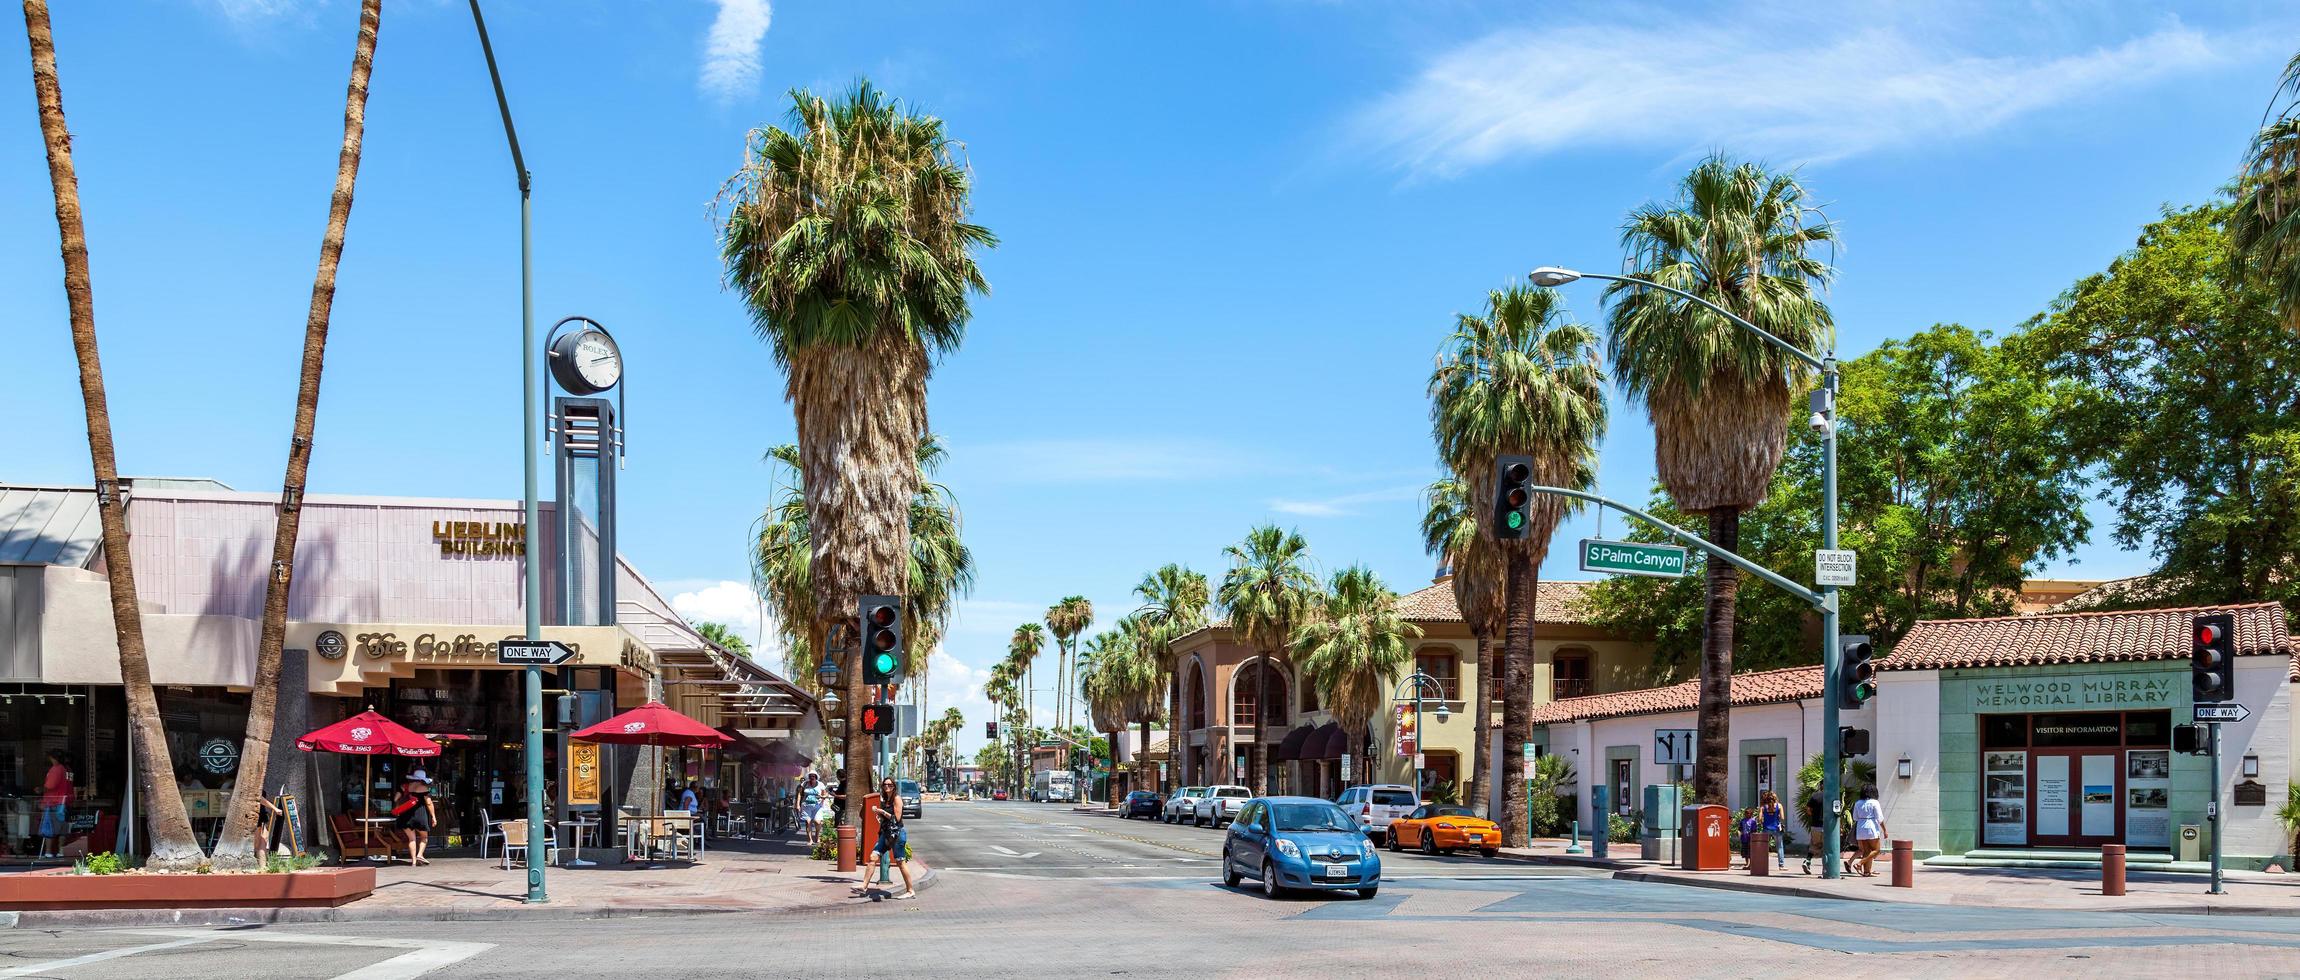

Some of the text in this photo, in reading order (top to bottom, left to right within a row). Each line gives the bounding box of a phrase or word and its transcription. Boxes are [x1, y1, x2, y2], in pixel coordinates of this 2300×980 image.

[583, 344, 608, 357] ROLEX
[1590, 547, 1681, 569] S Palm Canyon
[1819, 553, 1853, 563] DO NOT BLOCK
[1820, 563, 1852, 572] INTERSECTION
[356, 632, 498, 659] The Coffee
[506, 647, 551, 657] ONE WAY
[1977, 679, 2170, 695] WELWOOD MURRAY
[1976, 691, 2170, 707] MEMORIAL LIBRARY
[2198, 708, 2239, 717] ONE WAY
[2036, 726, 2118, 734] VISITOR INFORMATION
